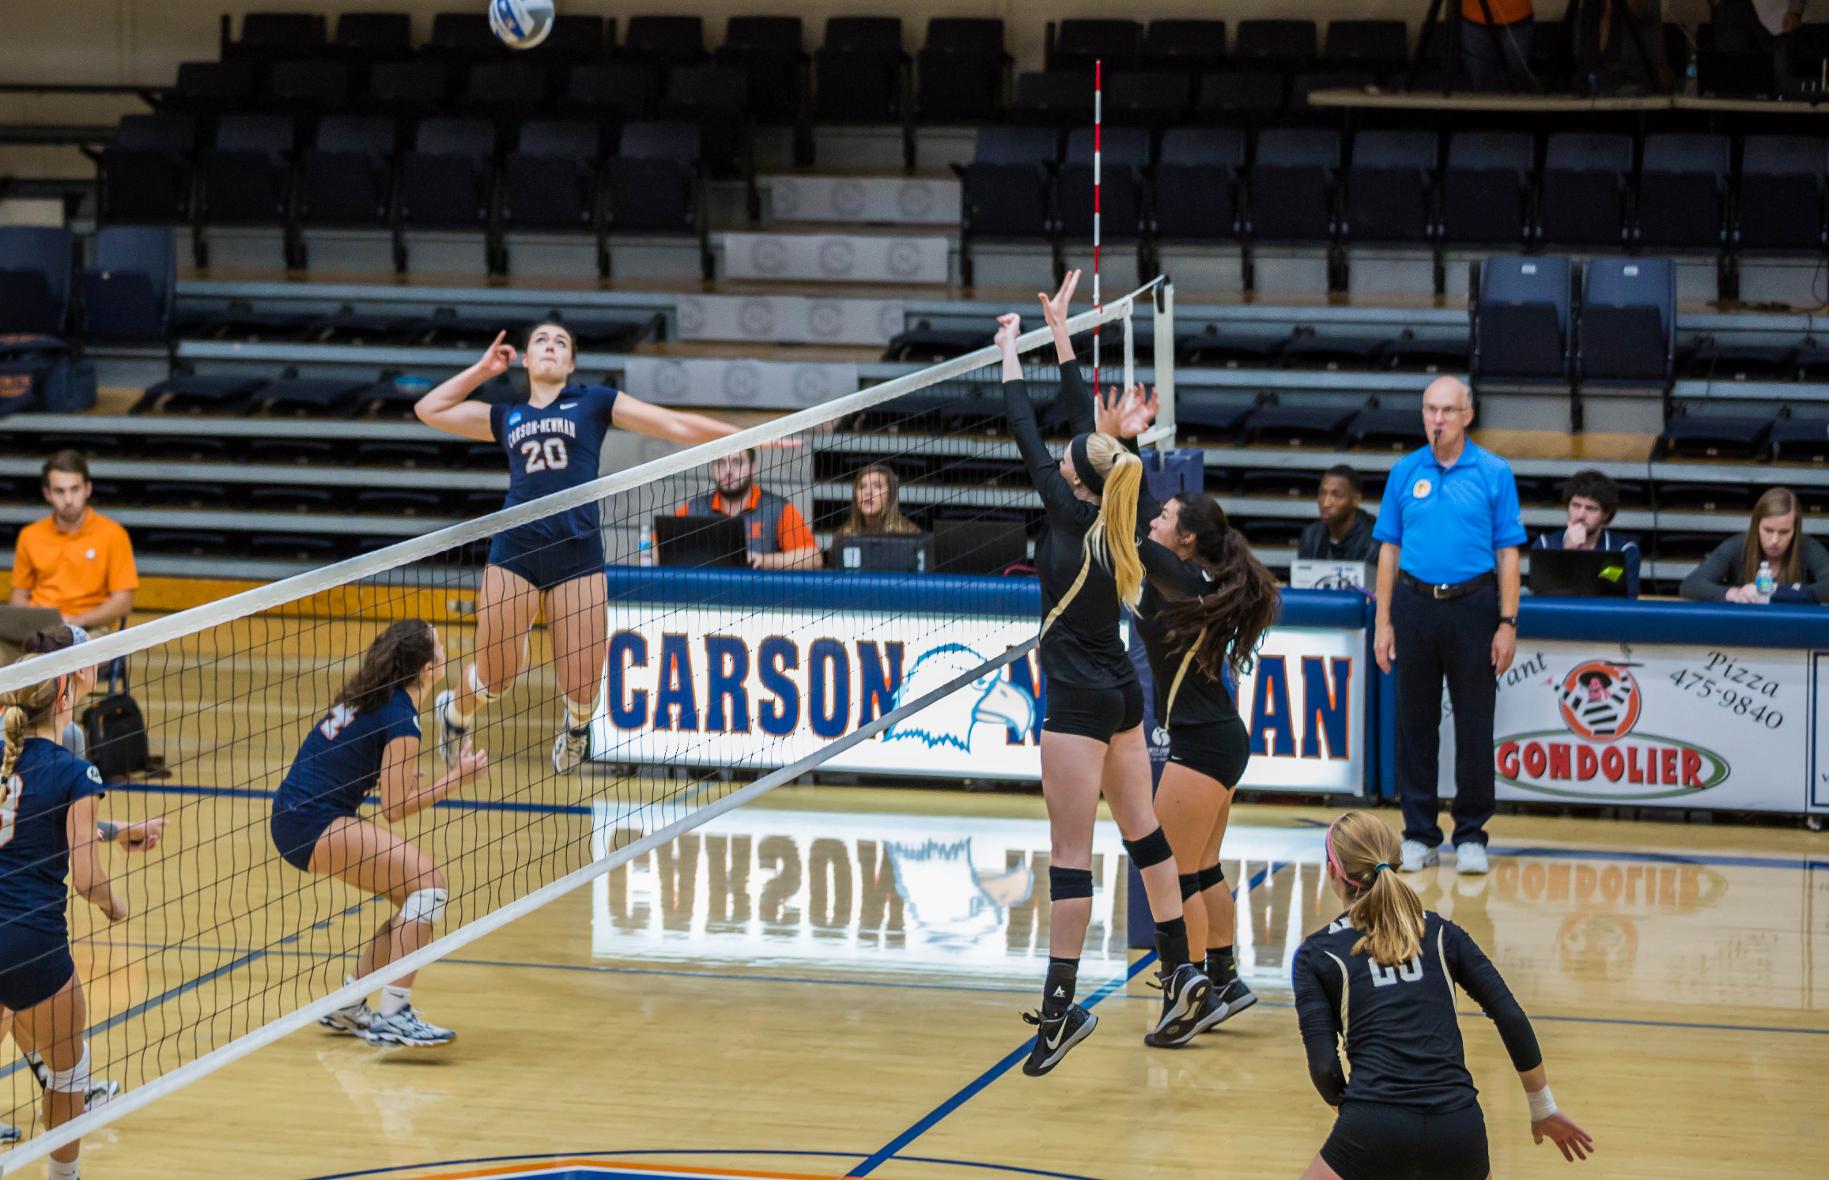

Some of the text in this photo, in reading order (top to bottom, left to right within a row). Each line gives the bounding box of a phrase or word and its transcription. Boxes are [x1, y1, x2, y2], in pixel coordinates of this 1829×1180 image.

[508, 417, 576, 449] CARSON-NEWMAN
[521, 437, 568, 474] 20
[606, 628, 905, 740] CARSON
[1704, 650, 1779, 698] Pizza
[1668, 668, 1784, 729] 475-9840
[1497, 740, 1706, 789] GONDOLIER
